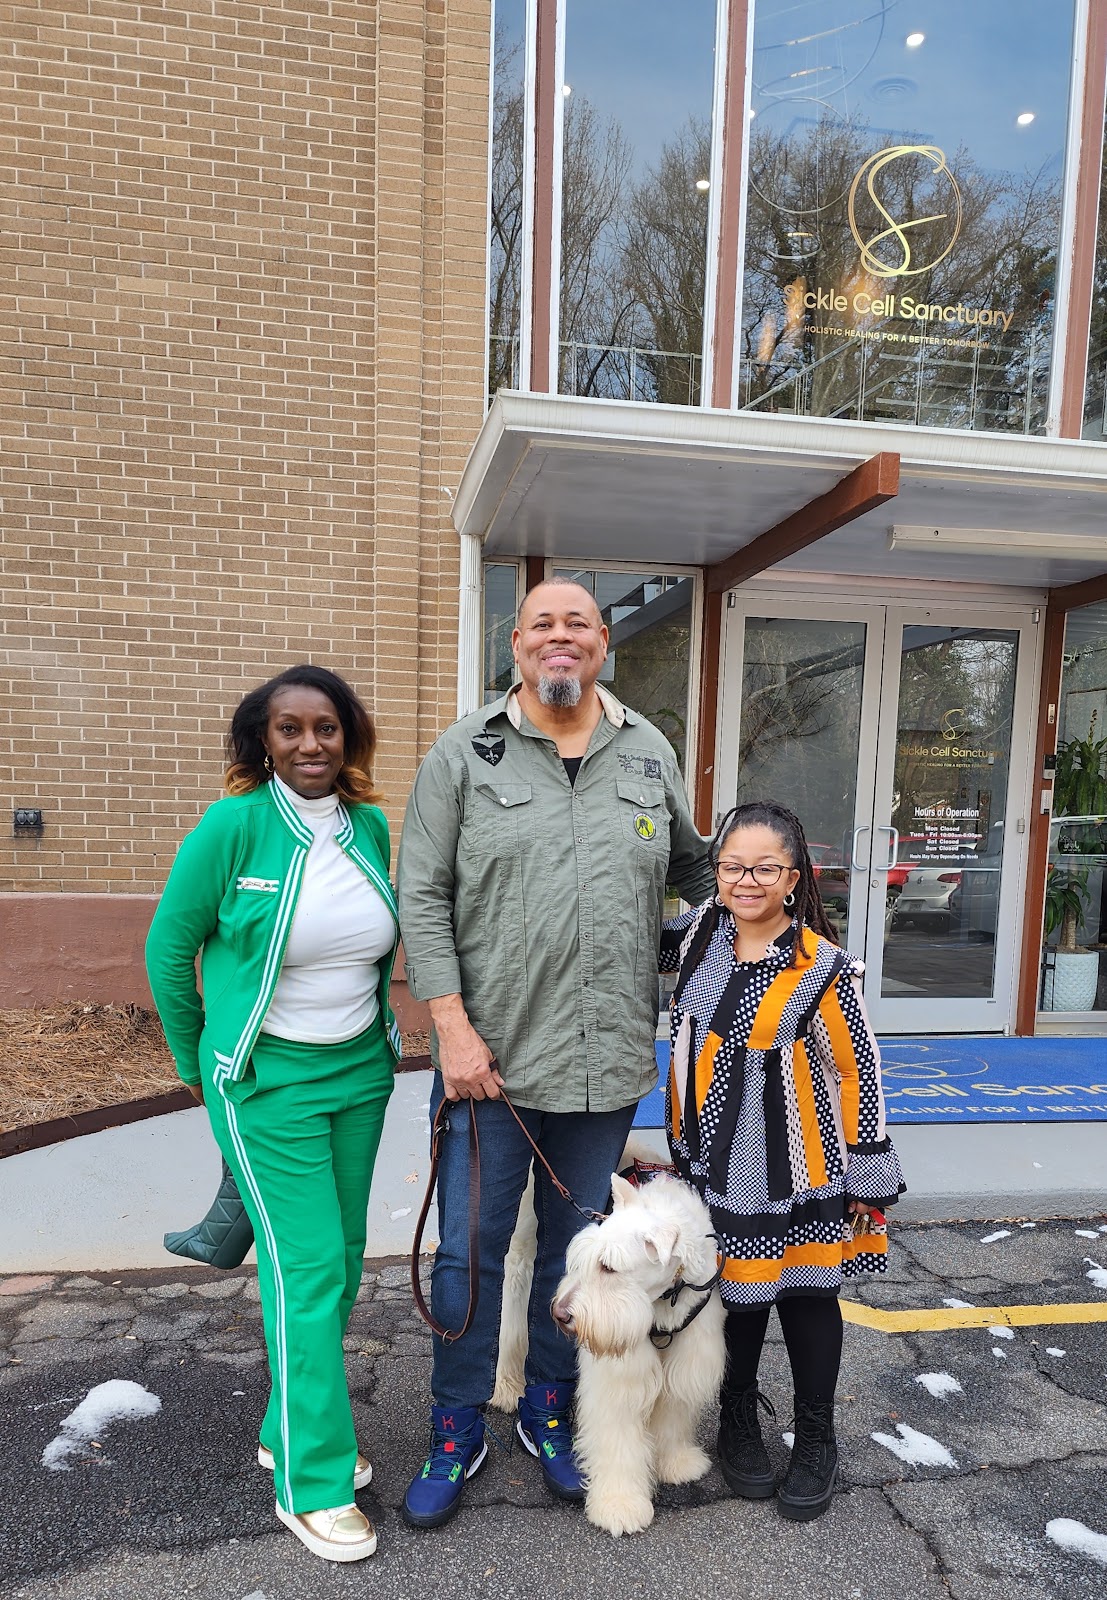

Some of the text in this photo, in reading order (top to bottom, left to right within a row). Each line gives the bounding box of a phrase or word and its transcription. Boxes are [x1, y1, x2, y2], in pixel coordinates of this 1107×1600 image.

[783, 285, 1014, 332] Sickle Cell Sanctuary
[804, 326, 842, 336] HOLISTIC
[845, 330, 880, 340] HEALING
[882, 333, 899, 342] FOR
[909, 336, 940, 345] BETTER
[942, 338, 990, 349] TOMORROW
[899, 745, 1004, 758] Sickle Cell Sanctu
[914, 806, 979, 818] Hours of Operation
[885, 1106, 964, 1114] ALING
[546, 1389, 558, 1406] K
[441, 1415, 455, 1430] K
